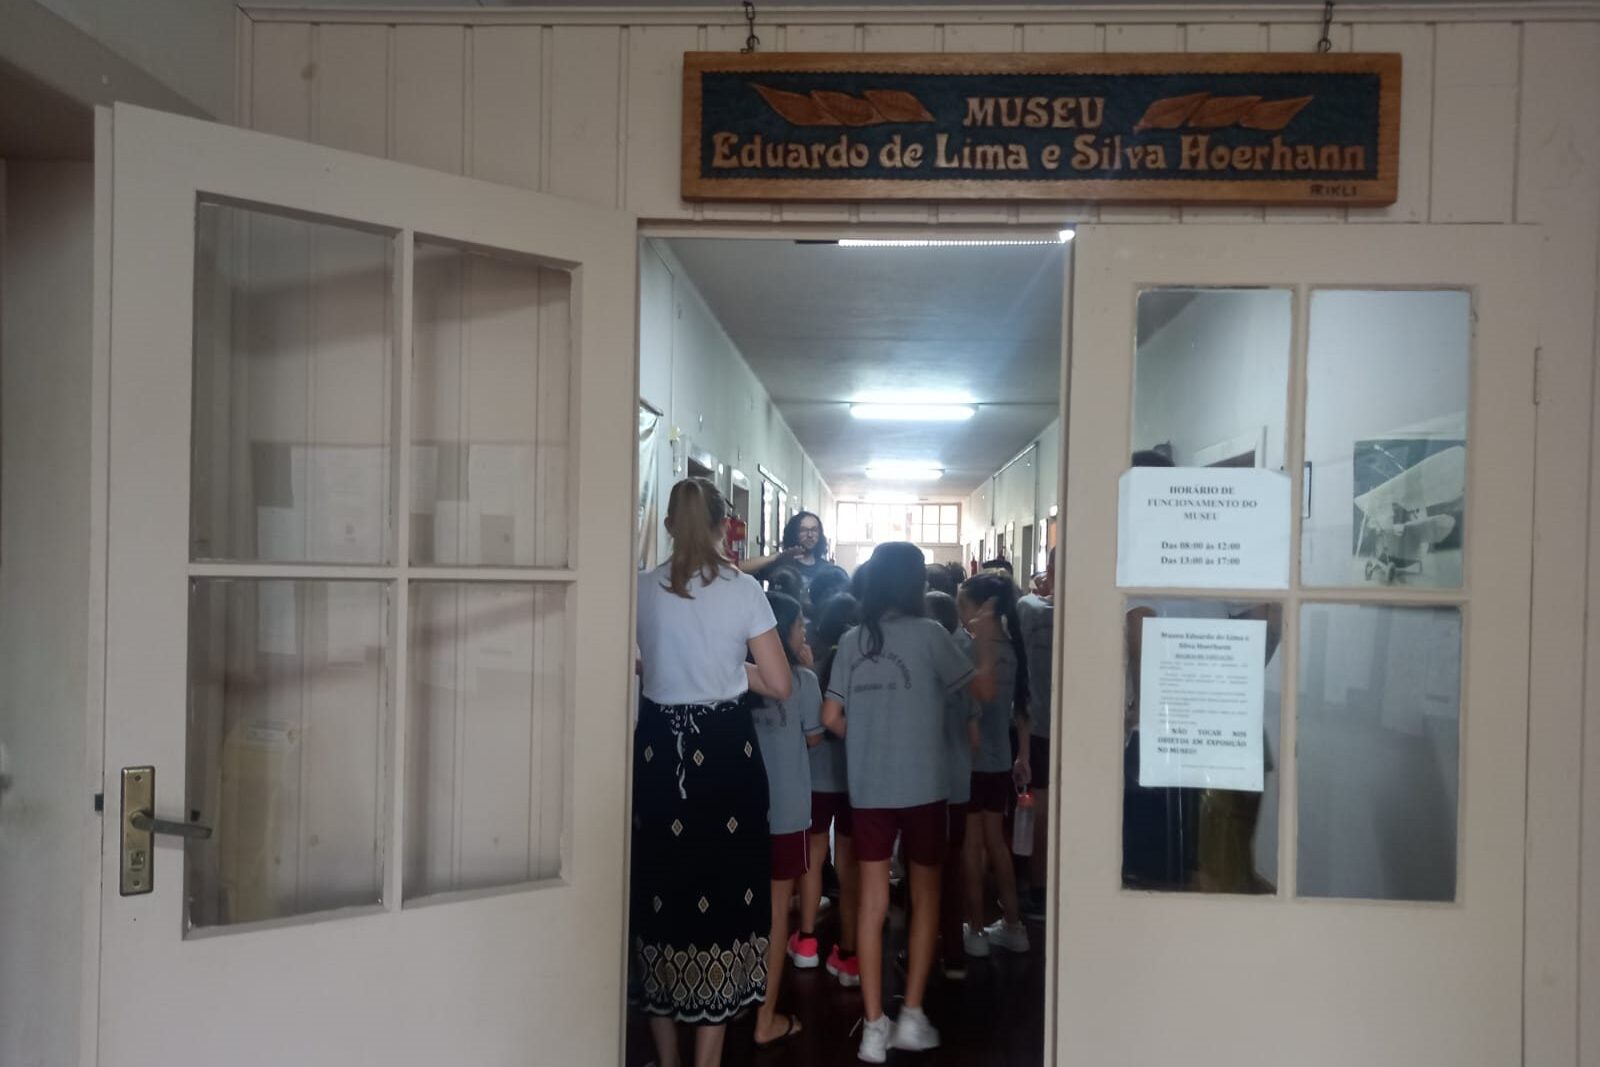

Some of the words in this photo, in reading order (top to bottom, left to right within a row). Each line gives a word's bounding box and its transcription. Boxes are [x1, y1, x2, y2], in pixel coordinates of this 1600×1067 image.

[963, 96, 1106, 130] MUSEU
[711, 132, 870, 170] Eduardo
[879, 134, 924, 169] de
[934, 133, 1029, 171] Lima
[1041, 143, 1059, 171] e
[1071, 134, 1168, 170] Silva
[1179, 134, 1366, 171] Hoerhann
[1169, 484, 1219, 495] HORÁRIO
[1221, 485, 1235, 496] DE
[1147, 498, 1240, 508] FUNCIONAMENTO
[1242, 499, 1258, 509] DO
[1184, 511, 1217, 520] MUSEU
[1161, 541, 1178, 550] Das
[1180, 541, 1204, 550] 08:00
[1218, 541, 1241, 551] 12:00
[1160, 556, 1178, 565] Das
[1180, 556, 1204, 565] 13:00
[1218, 556, 1241, 566] 17:00
[1199, 729, 1222, 737] TOCAR
[1192, 738, 1204, 746] EM
[1207, 738, 1248, 748] EXPOSIÇÃO
